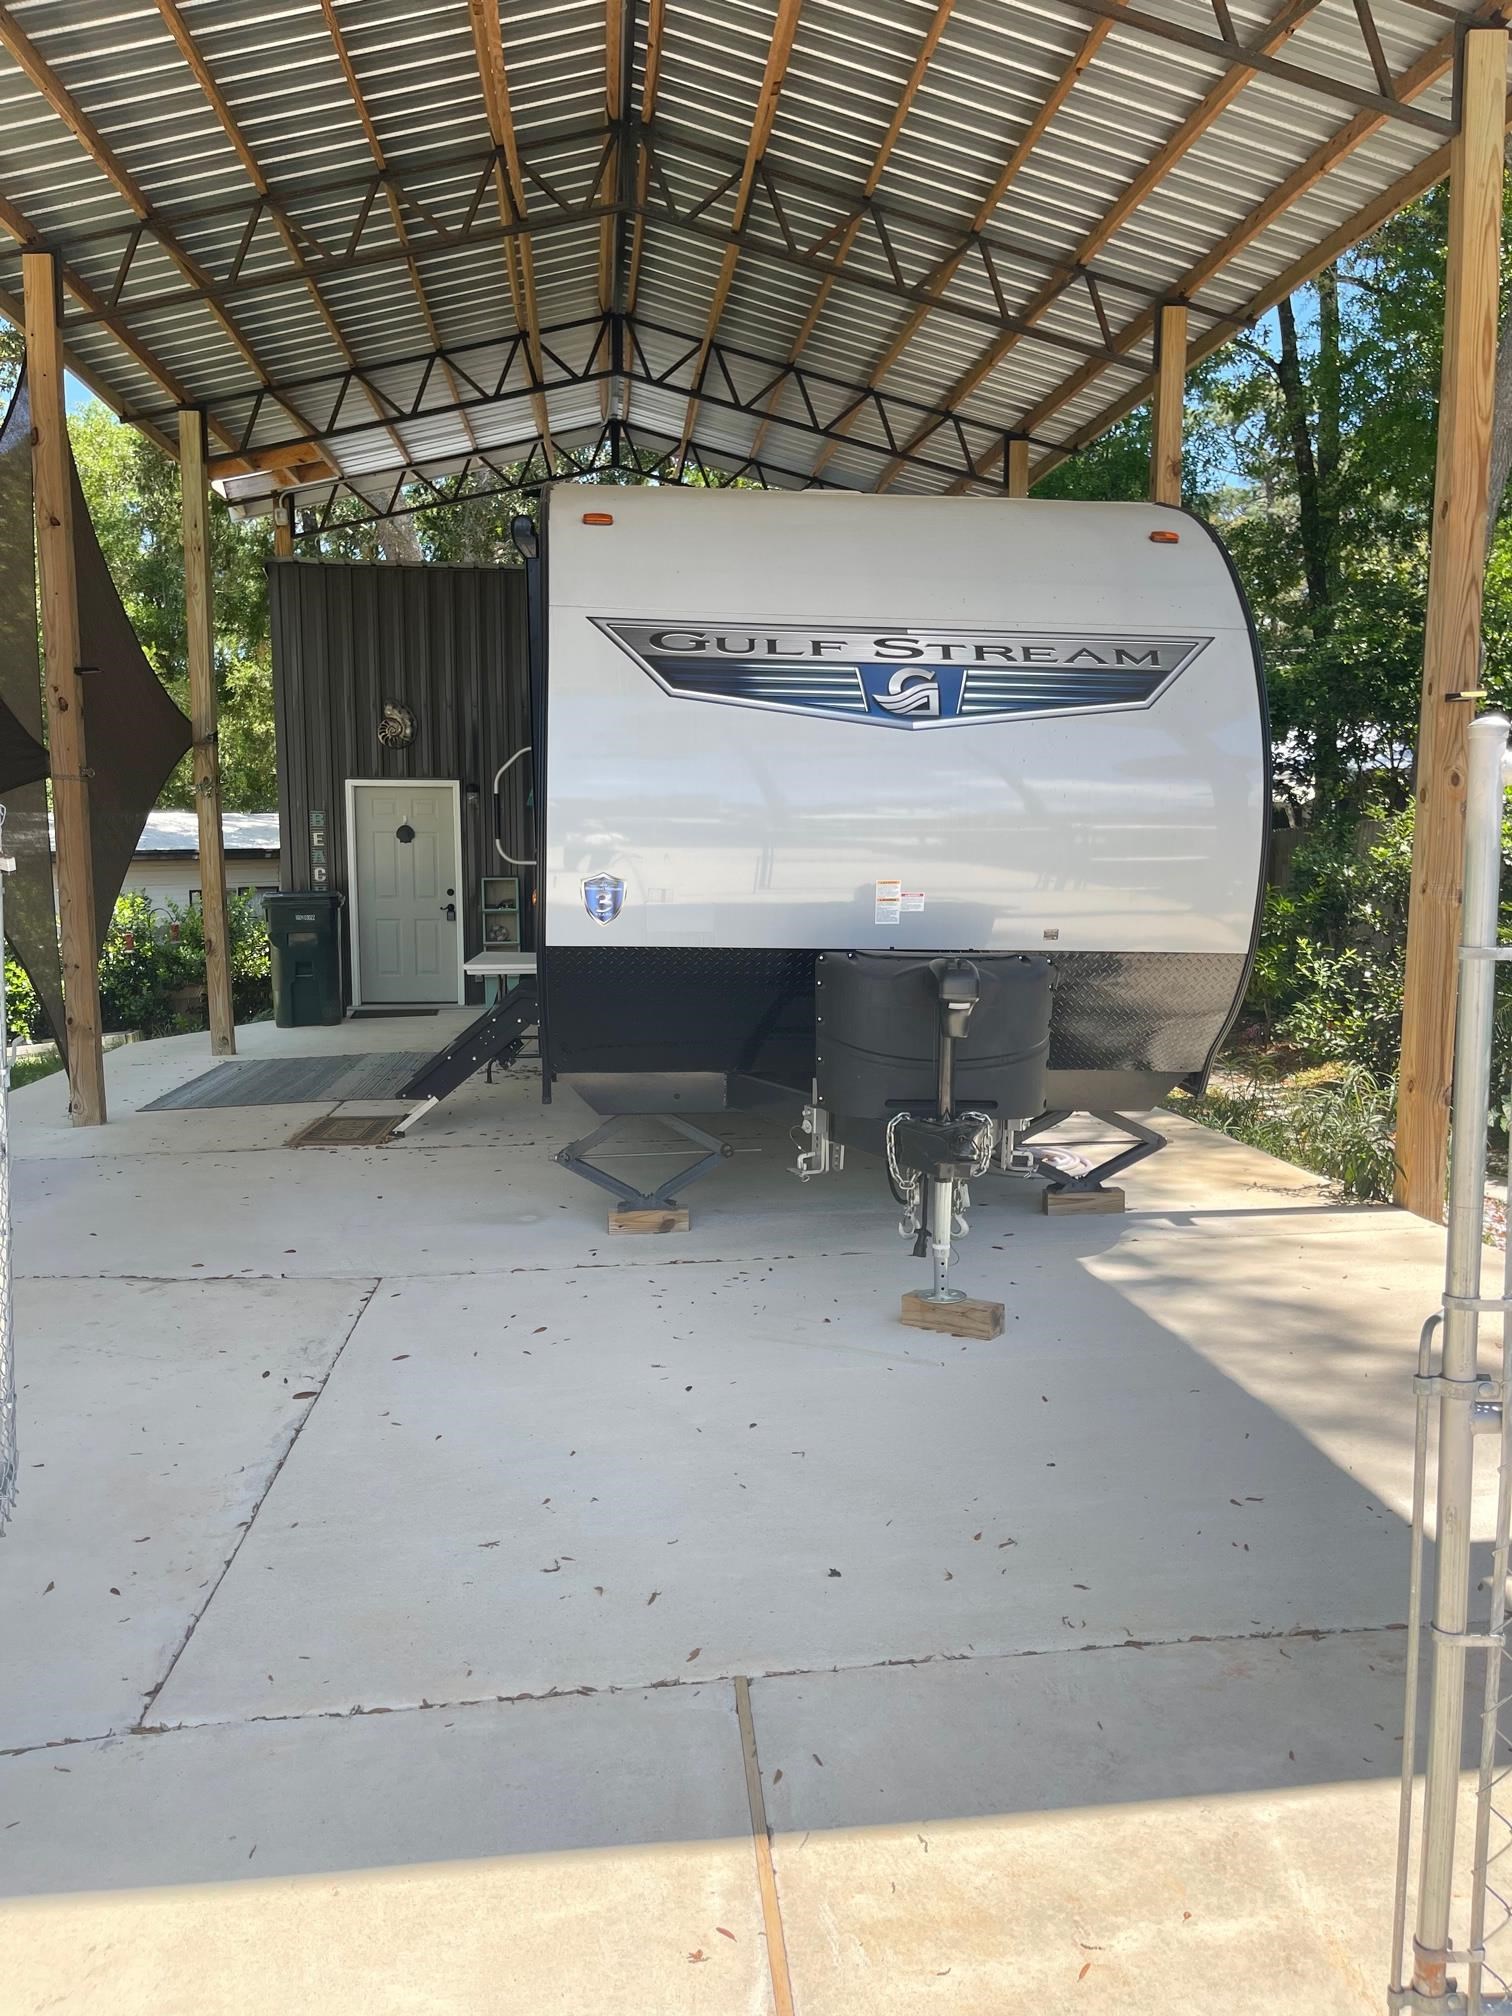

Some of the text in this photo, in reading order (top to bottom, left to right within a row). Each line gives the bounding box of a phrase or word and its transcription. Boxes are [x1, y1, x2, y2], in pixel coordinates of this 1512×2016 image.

[649, 630, 1162, 668] GULF STREAM
[595, 892, 613, 913] 3
